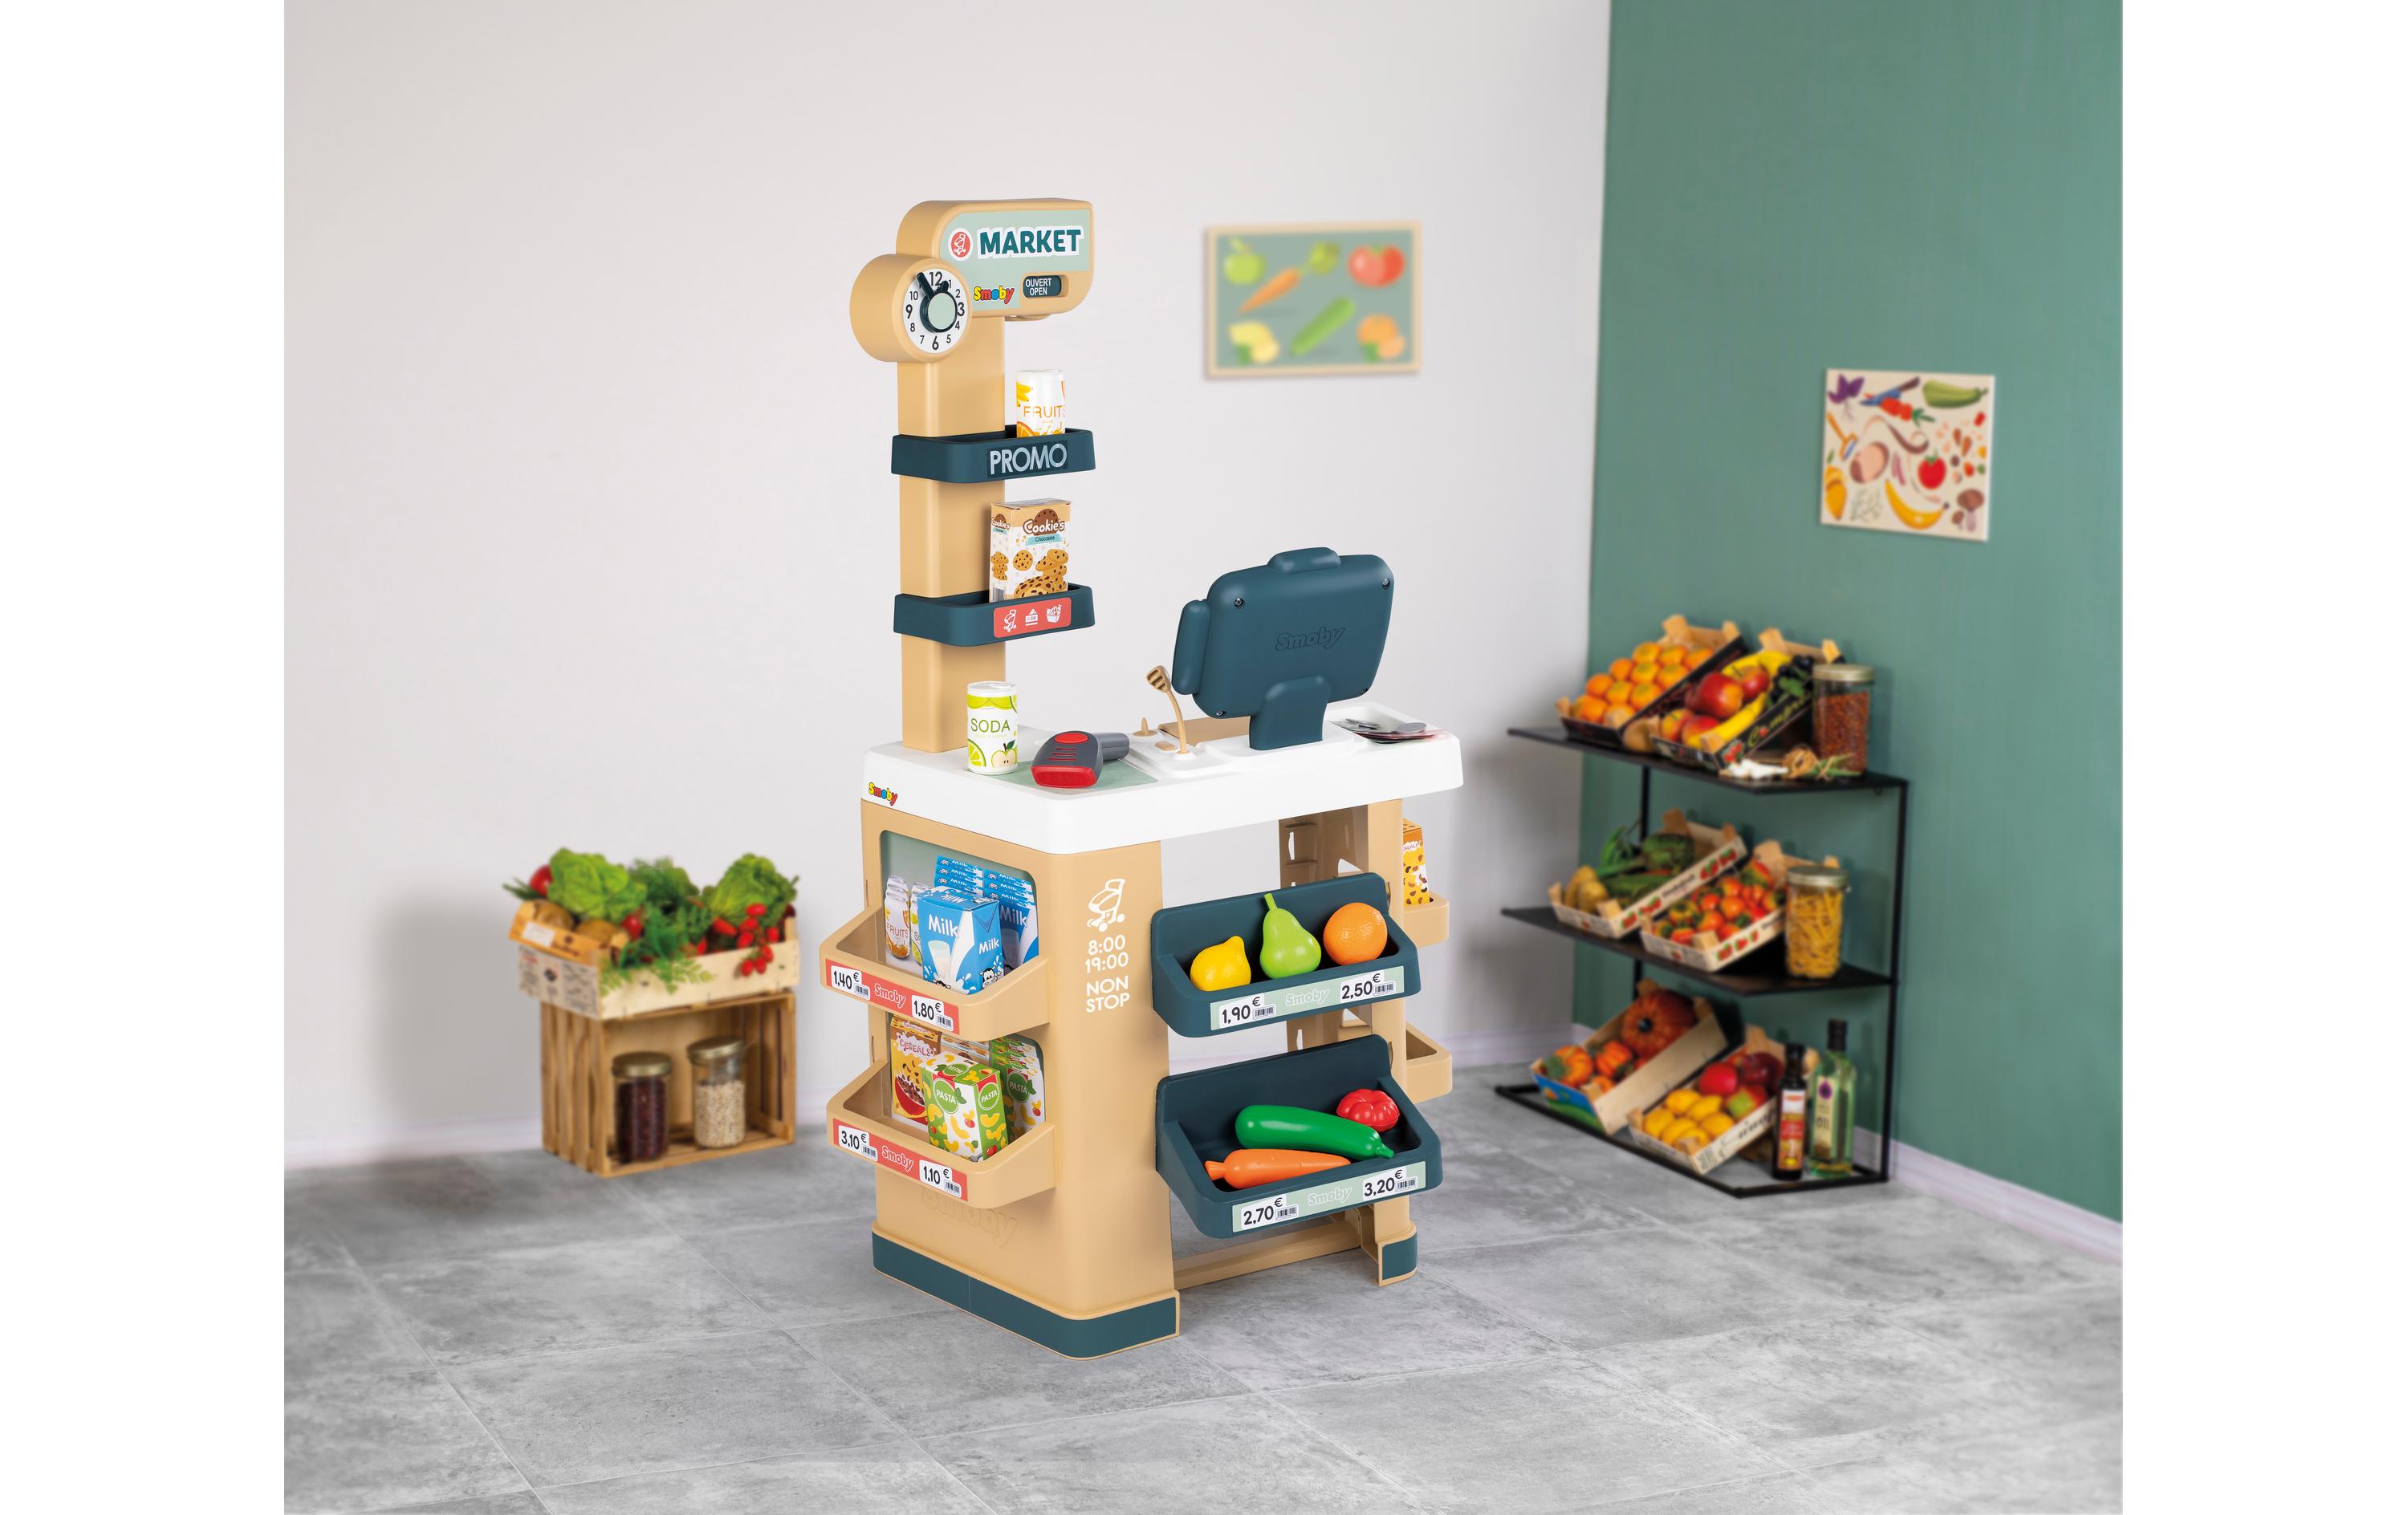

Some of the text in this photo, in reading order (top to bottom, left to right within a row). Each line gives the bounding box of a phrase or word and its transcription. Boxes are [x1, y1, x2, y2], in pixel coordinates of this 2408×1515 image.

[979, 229, 1081, 255] MARKET
[929, 271, 943, 286] 12
[1025, 278, 1051, 287] OUVERT
[909, 290, 919, 301] 10
[955, 289, 961, 298] 2
[973, 285, 1015, 304] Smoby
[1029, 286, 1047, 296] OPEN
[905, 304, 913, 319] 9
[957, 302, 965, 316] 3
[909, 323, 915, 332] 8
[954, 321, 960, 330] 4
[920, 335, 925, 344] 7
[932, 335, 939, 350] 6
[946, 335, 951, 343] 5
[1023, 405, 1066, 418] FRUITS
[990, 443, 1068, 475] PROMO
[1023, 518, 1065, 535] Cookie's
[1275, 626, 1346, 651] Smoby
[970, 717, 1011, 733] SODA
[868, 782, 898, 806] Smoby
[951, 859, 968, 867] Milk
[1000, 905, 1027, 928] Milk
[928, 914, 959, 938] Milk
[978, 937, 1000, 954] Milk
[1088, 934, 1126, 956] 8:00
[1084, 952, 1129, 973] 19:00
[1086, 975, 1129, 997] NON
[873, 983, 907, 1009] Smoby
[1085, 992, 1130, 1013] STOP
[1284, 988, 1331, 1007] Smoby
[899, 1038, 931, 1057] CEREALS
[1009, 1081, 1027, 1095] PASTA
[936, 1090, 957, 1104] PASTA
[981, 1090, 998, 1104] PASTA
[881, 1145, 914, 1172] Smoby
[1308, 1188, 1352, 1206] Smoby
